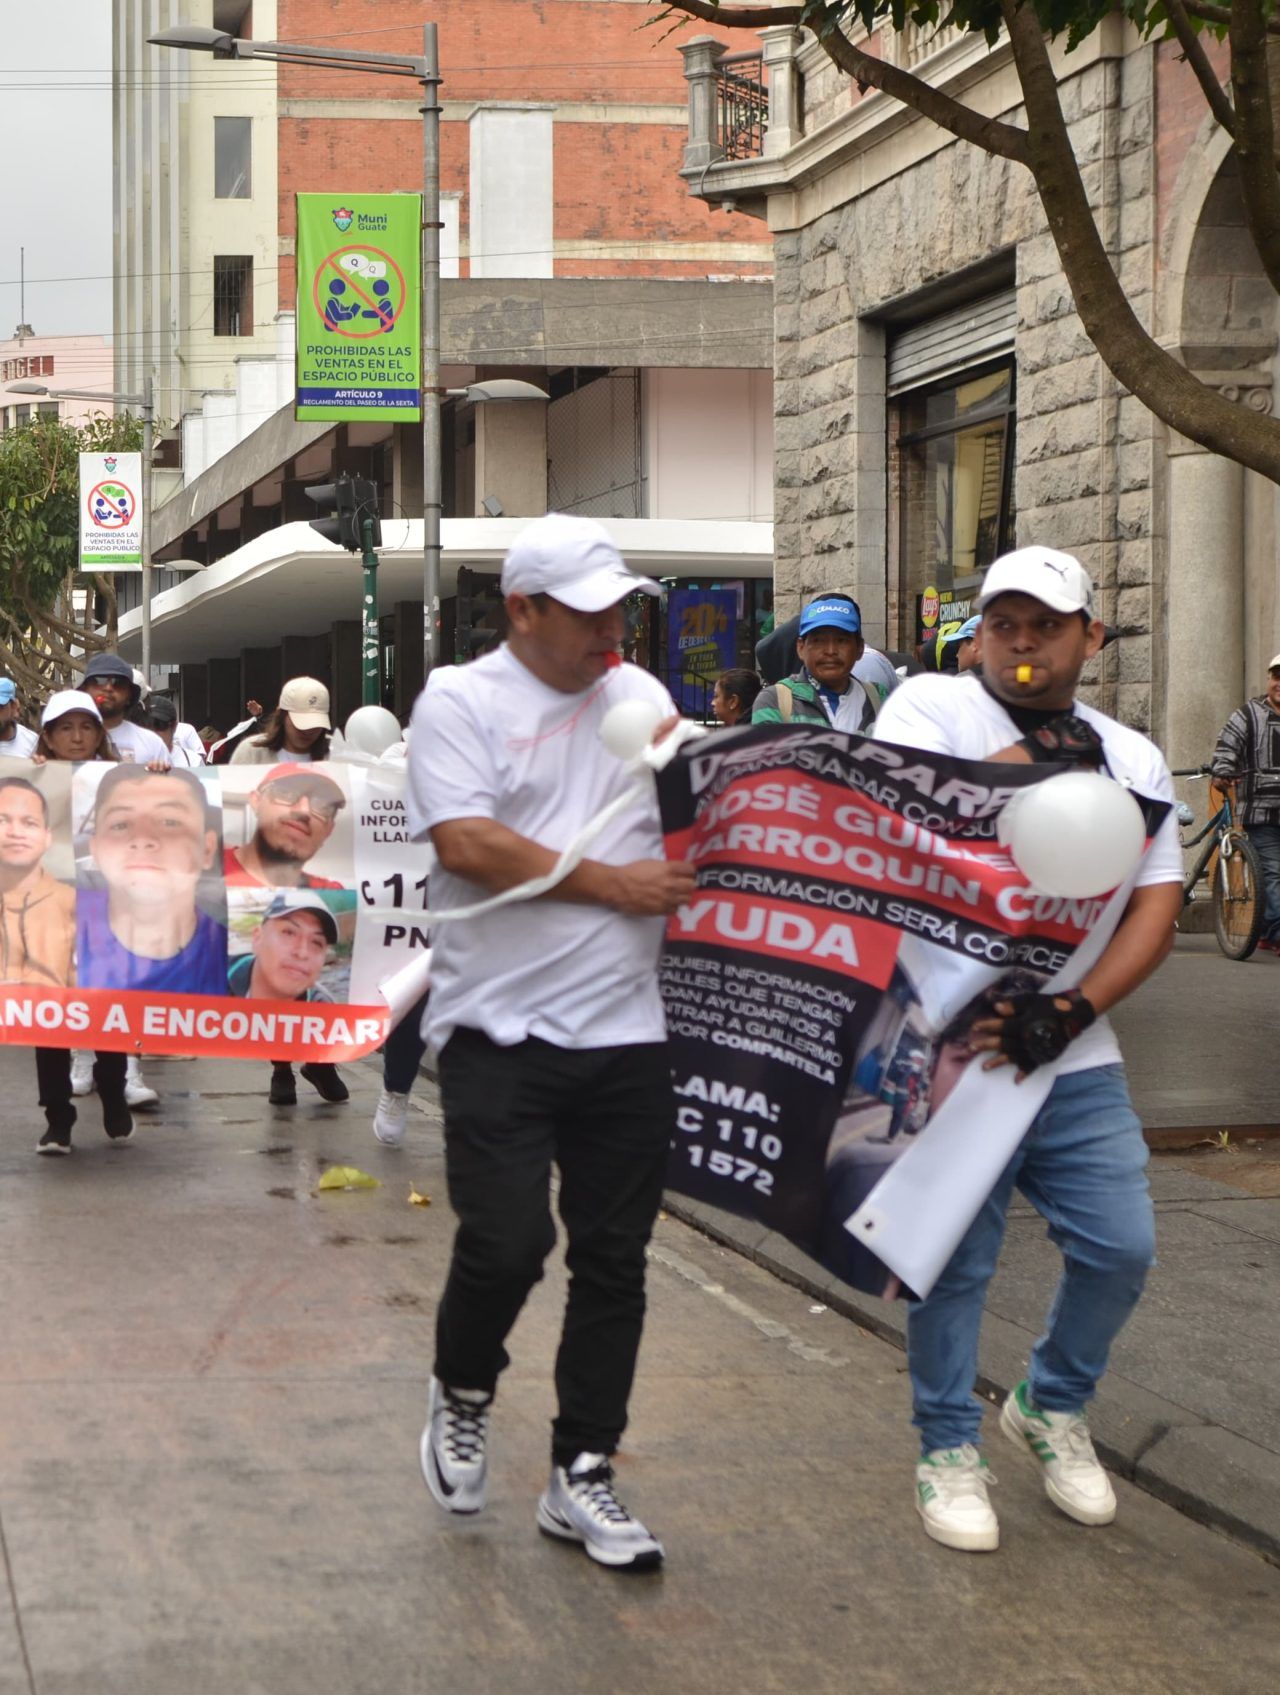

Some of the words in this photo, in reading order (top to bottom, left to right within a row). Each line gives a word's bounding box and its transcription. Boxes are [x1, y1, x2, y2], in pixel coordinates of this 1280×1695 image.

[358, 213, 388, 223] Muni
[358, 223, 388, 231] Guate
[306, 345, 385, 356] PROHIBIDAS
[388, 346, 412, 357] LAS
[314, 358, 365, 369] VENTAS
[368, 359, 385, 369] EN
[388, 359, 403, 369] EL
[303, 371, 358, 381] ESPACIO
[360, 369, 415, 382] PÚBLICO
[335, 390, 376, 398] ARTÍCULO
[377, 391, 383, 399] 9
[940, 600, 971, 621] CRUNCHY
[689, 731, 1022, 819] DESAPARE
[848, 768, 900, 810] DAR
[702, 783, 821, 832] JOSÉ
[383, 924, 432, 949] PN
[675, 899, 860, 967] YUDA
[884, 901, 958, 945] SERÁ
[660, 954, 721, 974] QUIER
[724, 964, 856, 1013] INFORMACIÓN
[661, 969, 721, 991] ALLES
[724, 981, 769, 1002] QUE
[772, 991, 842, 1028] TENGAS
[101, 1003, 131, 1034] A
[143, 1005, 391, 1046] ENCONTRAR
[660, 984, 703, 1003] DAN
[705, 992, 822, 1039] AYUDARNOS
[821, 1030, 837, 1046] A
[667, 1019, 710, 1042] VOR
[711, 1029, 836, 1086] COMPARTELA
[727, 1017, 742, 1032] A
[745, 1020, 843, 1068] GUILLERMO
[717, 1118, 783, 1160] 110
[687, 1144, 774, 1196] 1572
